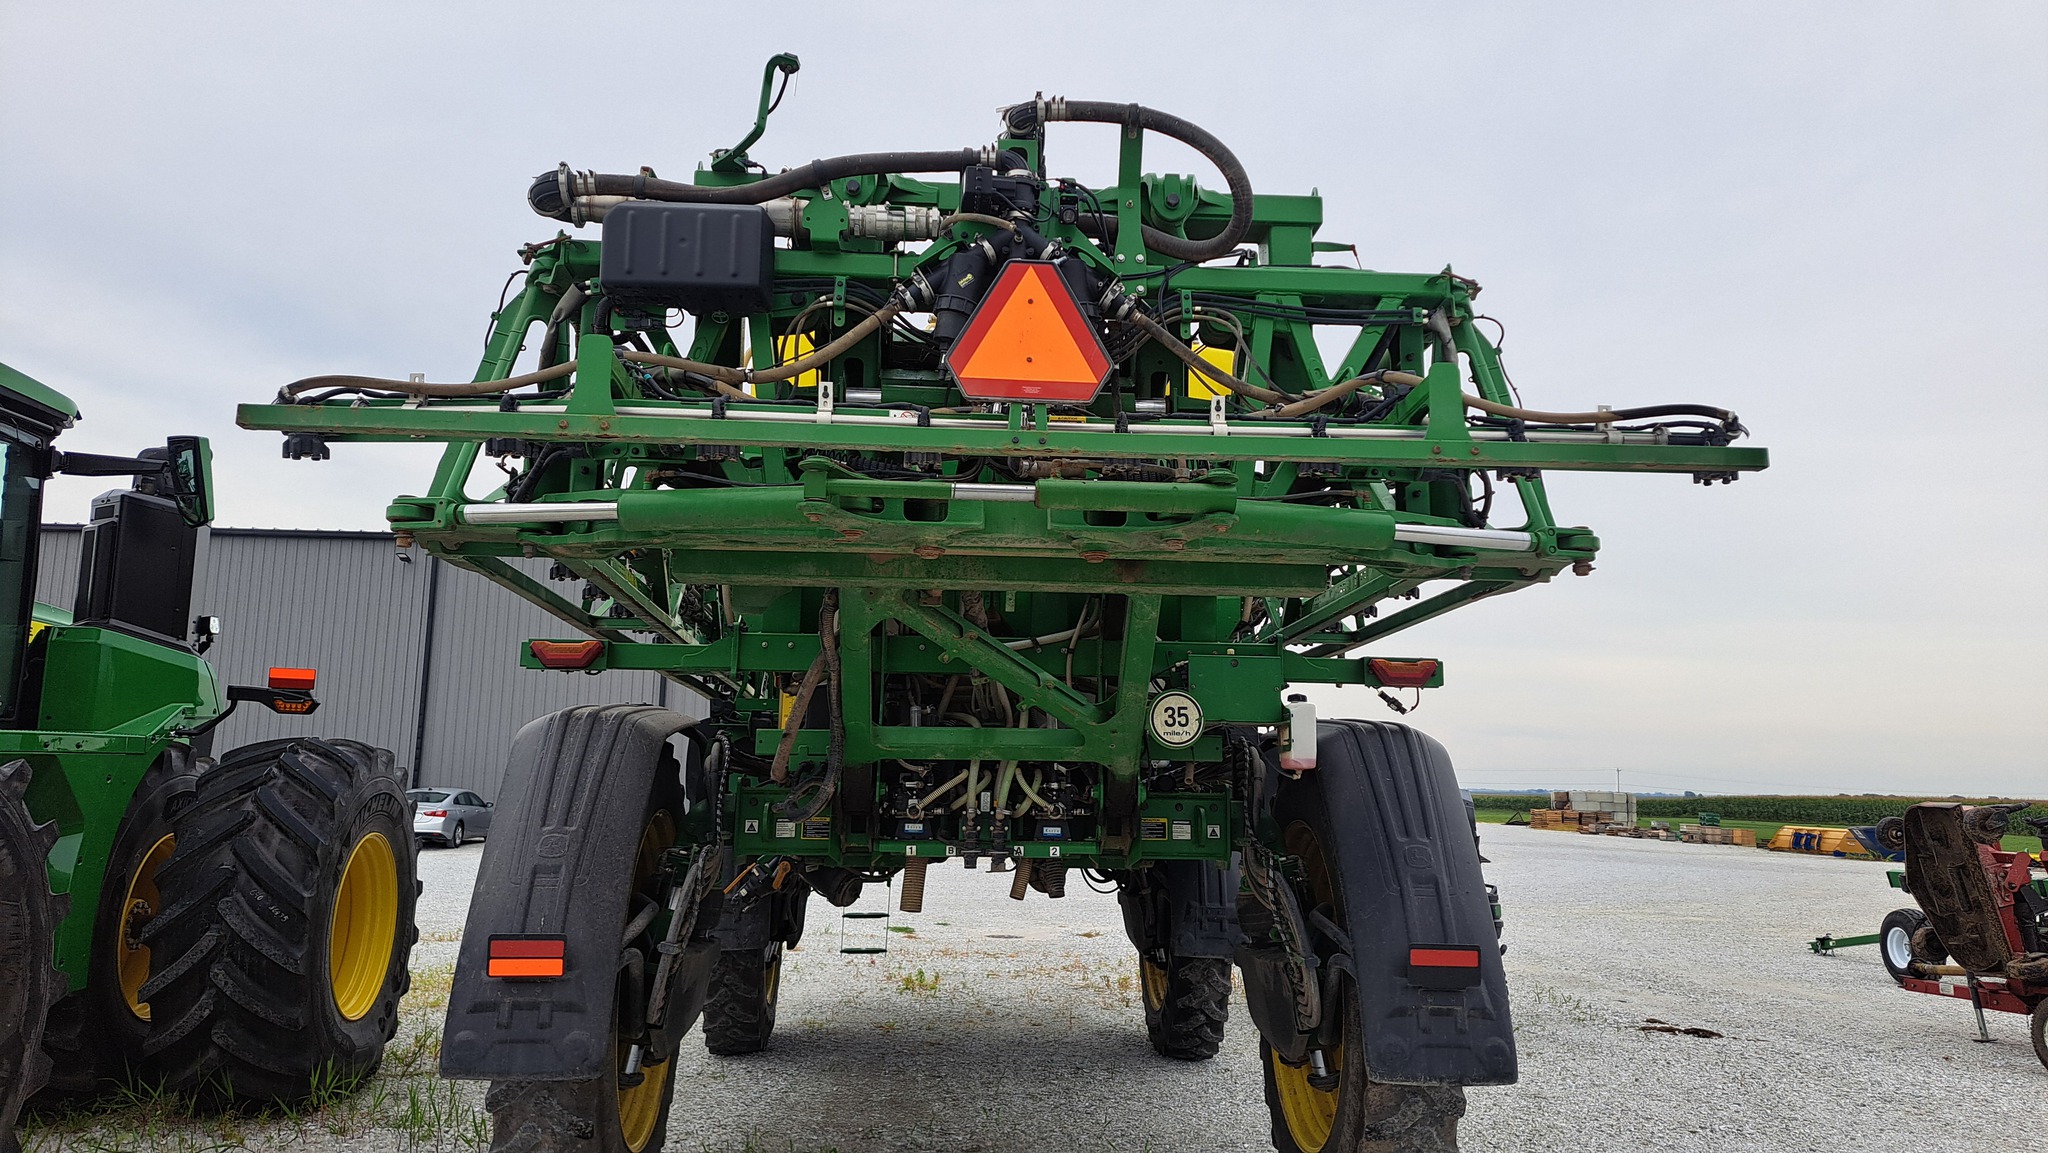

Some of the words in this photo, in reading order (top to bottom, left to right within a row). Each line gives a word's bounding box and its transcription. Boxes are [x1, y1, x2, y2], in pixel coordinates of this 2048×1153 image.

[1164, 706, 1189, 727] 35
[908, 846, 913, 854] 1
[948, 846, 954, 854] B
[1015, 846, 1022, 855] A
[1051, 847, 1058, 855] 2
